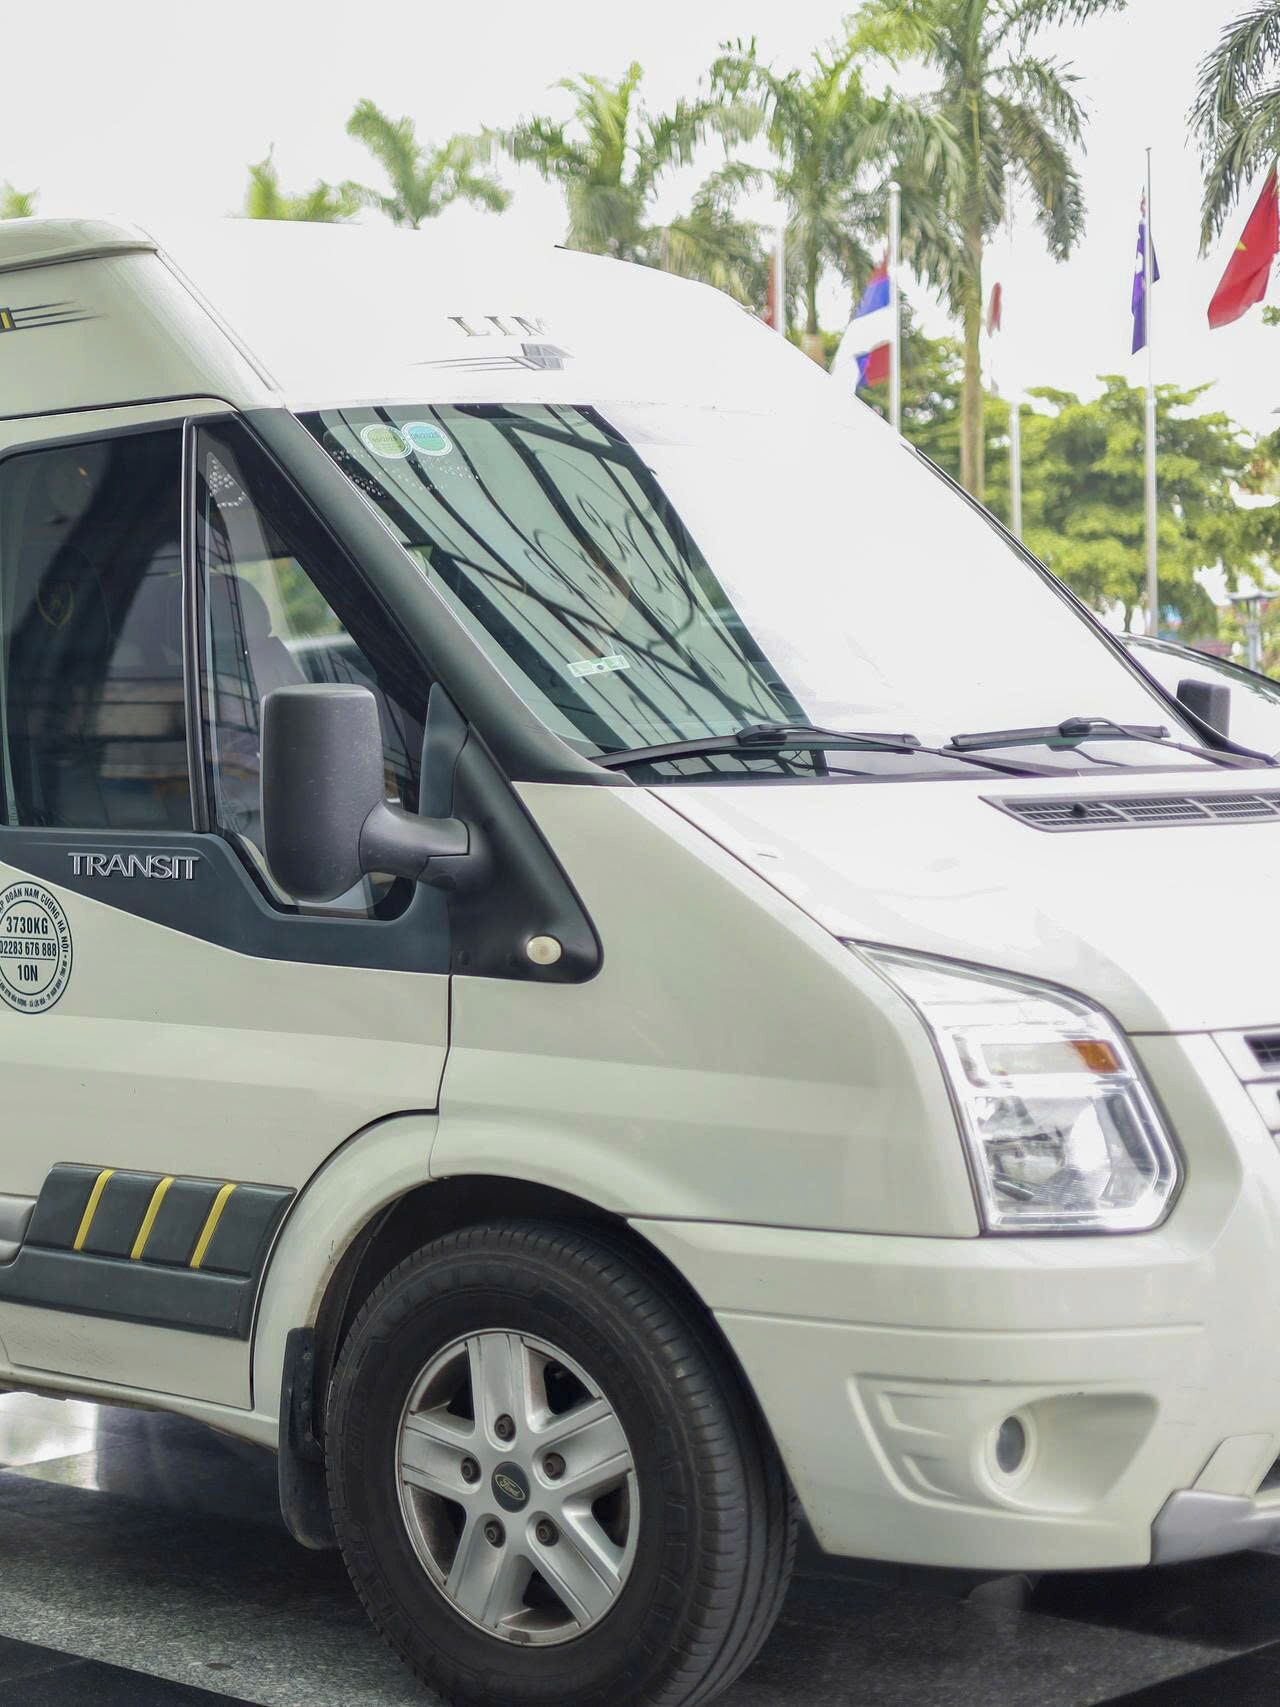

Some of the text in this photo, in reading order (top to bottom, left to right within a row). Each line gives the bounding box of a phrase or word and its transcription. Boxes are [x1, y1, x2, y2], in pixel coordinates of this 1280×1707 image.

[67, 851, 200, 880] TRANSIT
[24, 887, 40, 900] NAM
[6, 916, 48, 935] 3730KG
[0, 940, 57, 957] 02283 676 888
[17, 964, 38, 982] 10N
